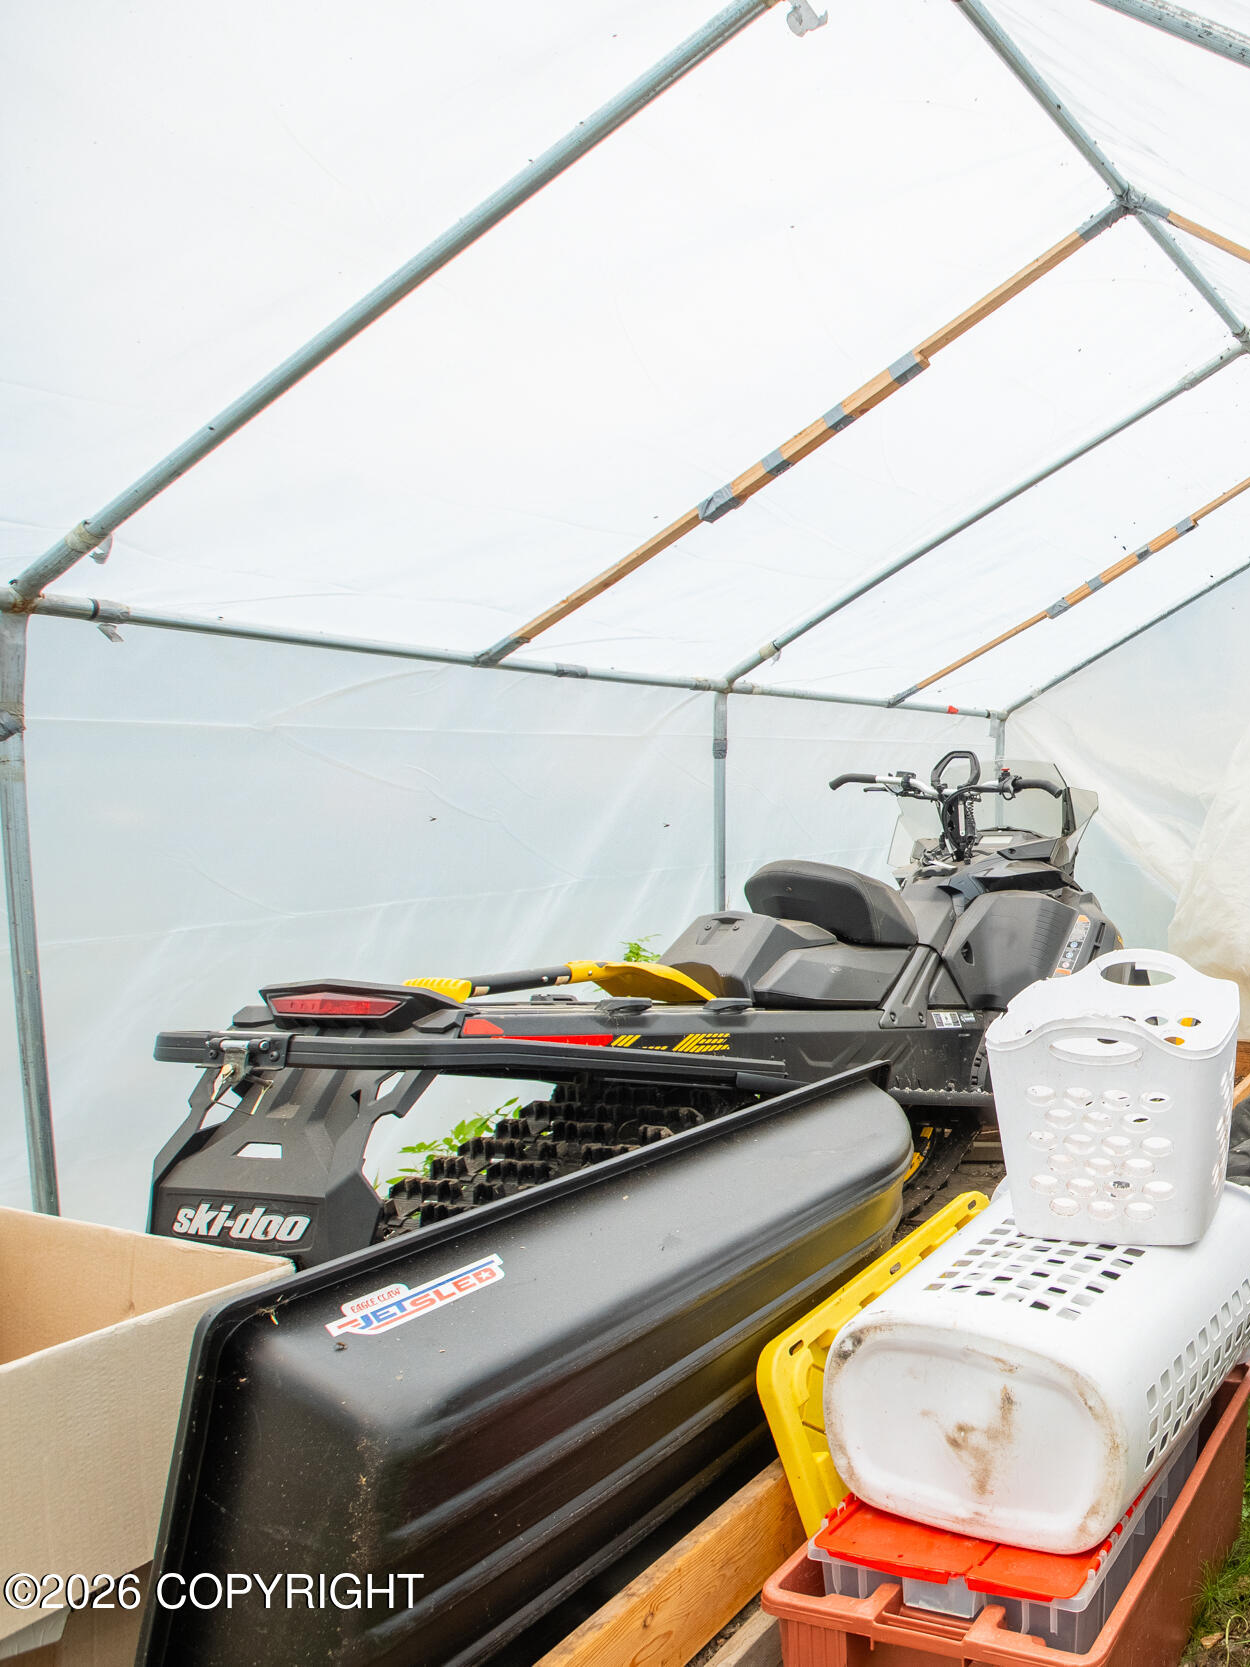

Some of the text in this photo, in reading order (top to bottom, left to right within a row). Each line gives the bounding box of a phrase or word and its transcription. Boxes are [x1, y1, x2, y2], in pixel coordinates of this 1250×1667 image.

[172, 1203, 311, 1242] ski-doo
[350, 1287, 401, 1314] EAGLE CLAW
